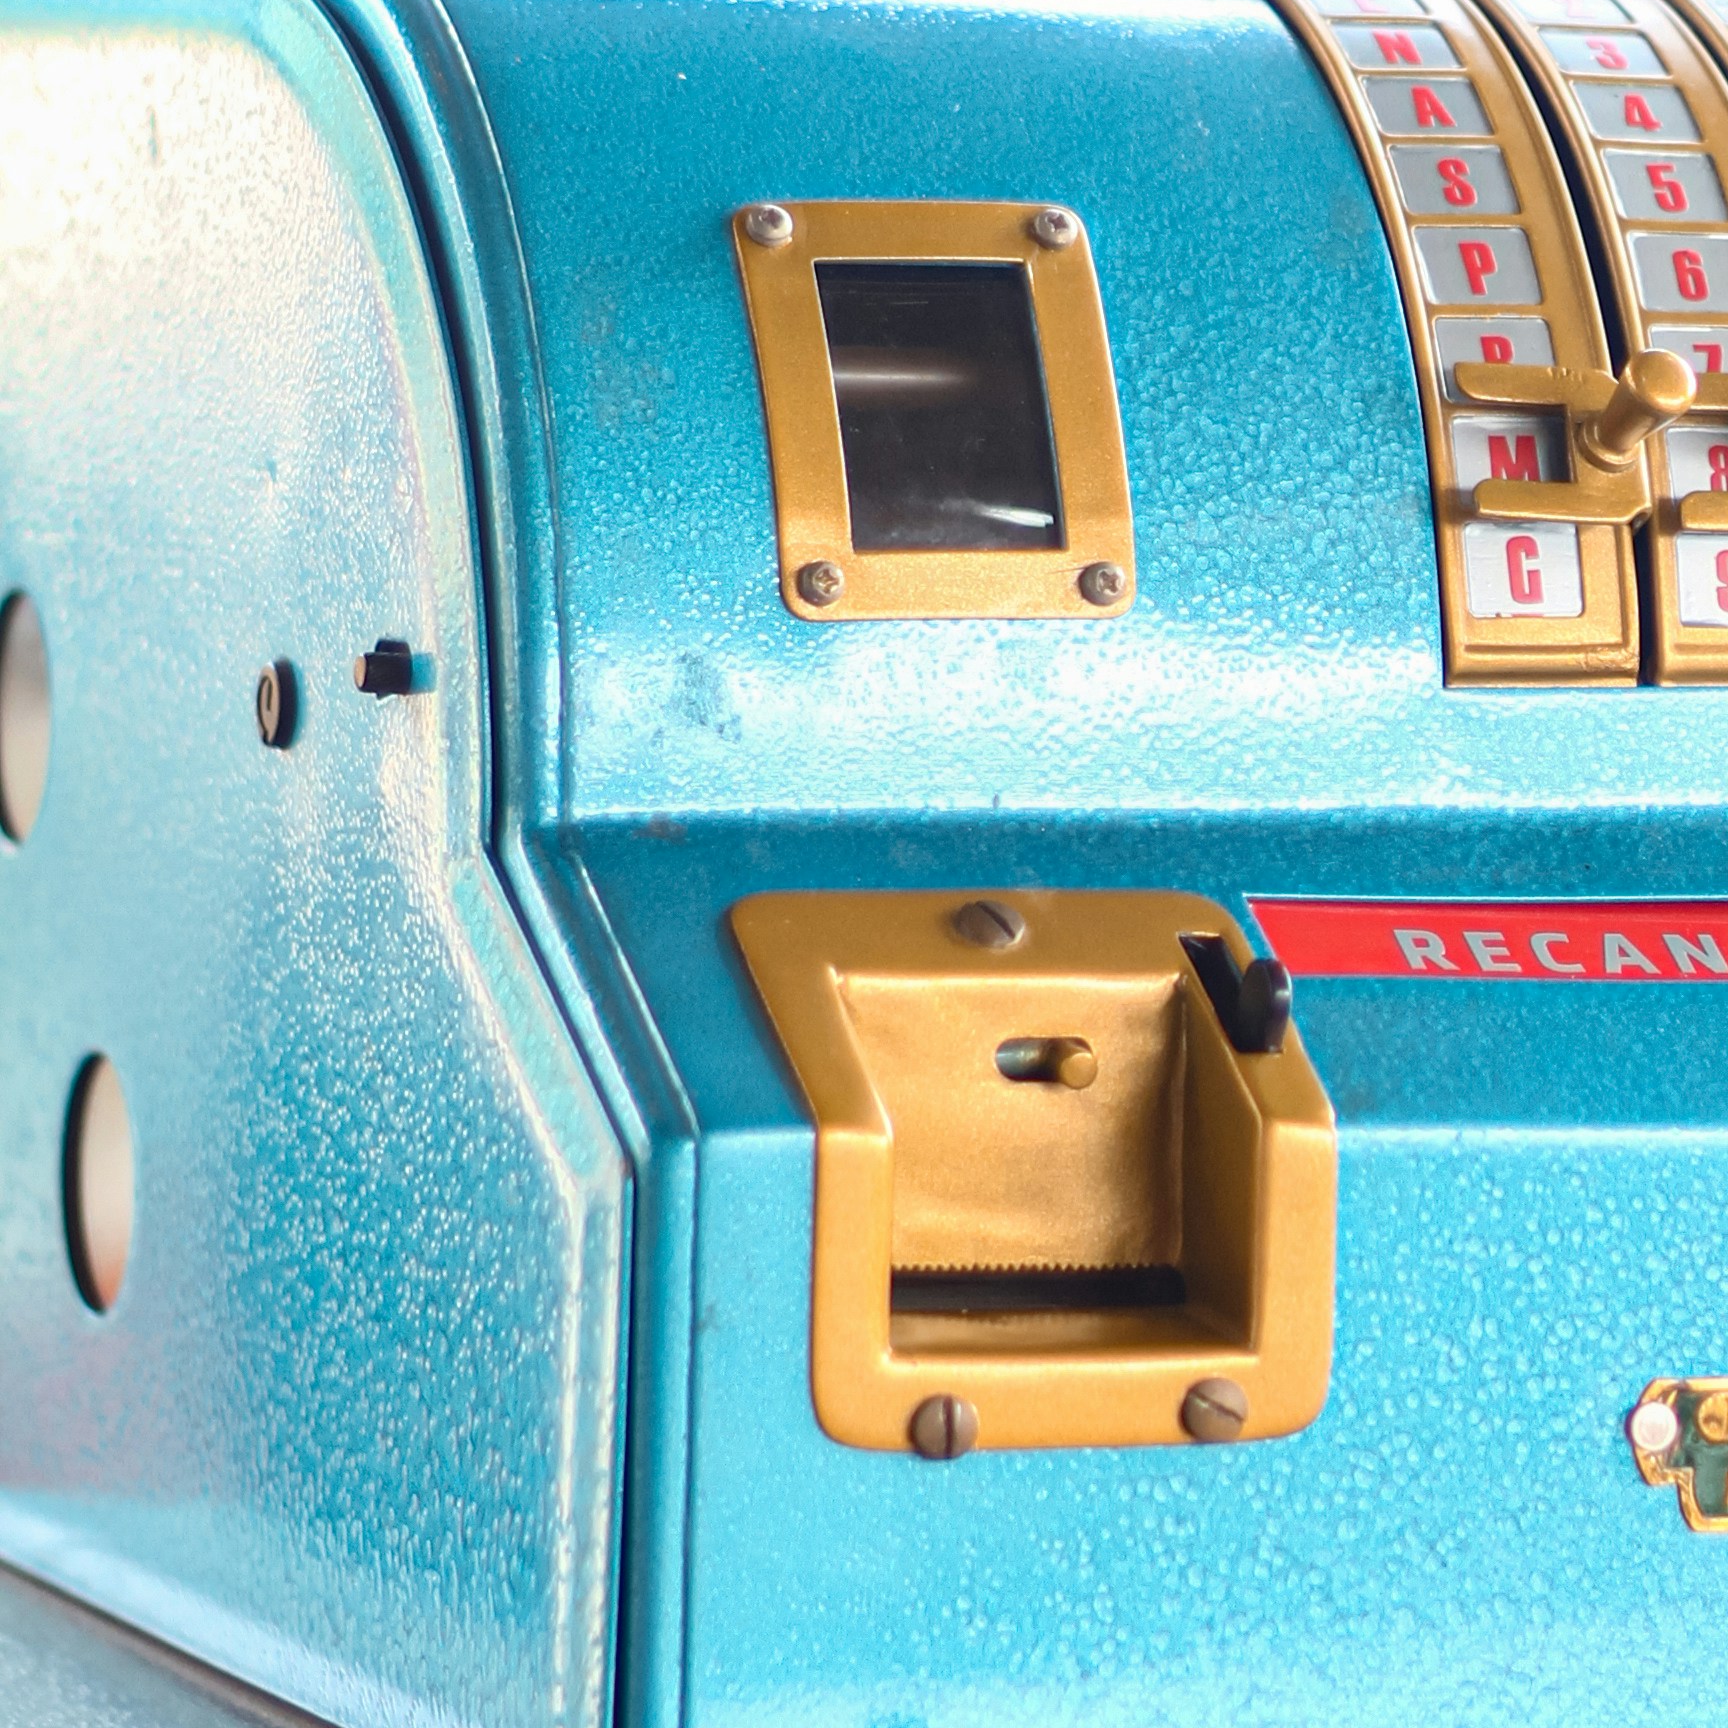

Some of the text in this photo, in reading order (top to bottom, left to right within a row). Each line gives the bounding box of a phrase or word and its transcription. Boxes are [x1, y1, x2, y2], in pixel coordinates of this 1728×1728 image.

[1371, 30, 1423, 65] N
[1586, 37, 1630, 71] 3
[1410, 85, 1456, 129] A
[1623, 92, 1662, 132] 4
[1436, 156, 1478, 208] S
[1646, 162, 1689, 214] 5
[1457, 239, 1498, 297] P
[1671, 247, 1710, 303] 6
[1486, 434, 1541, 482] M
